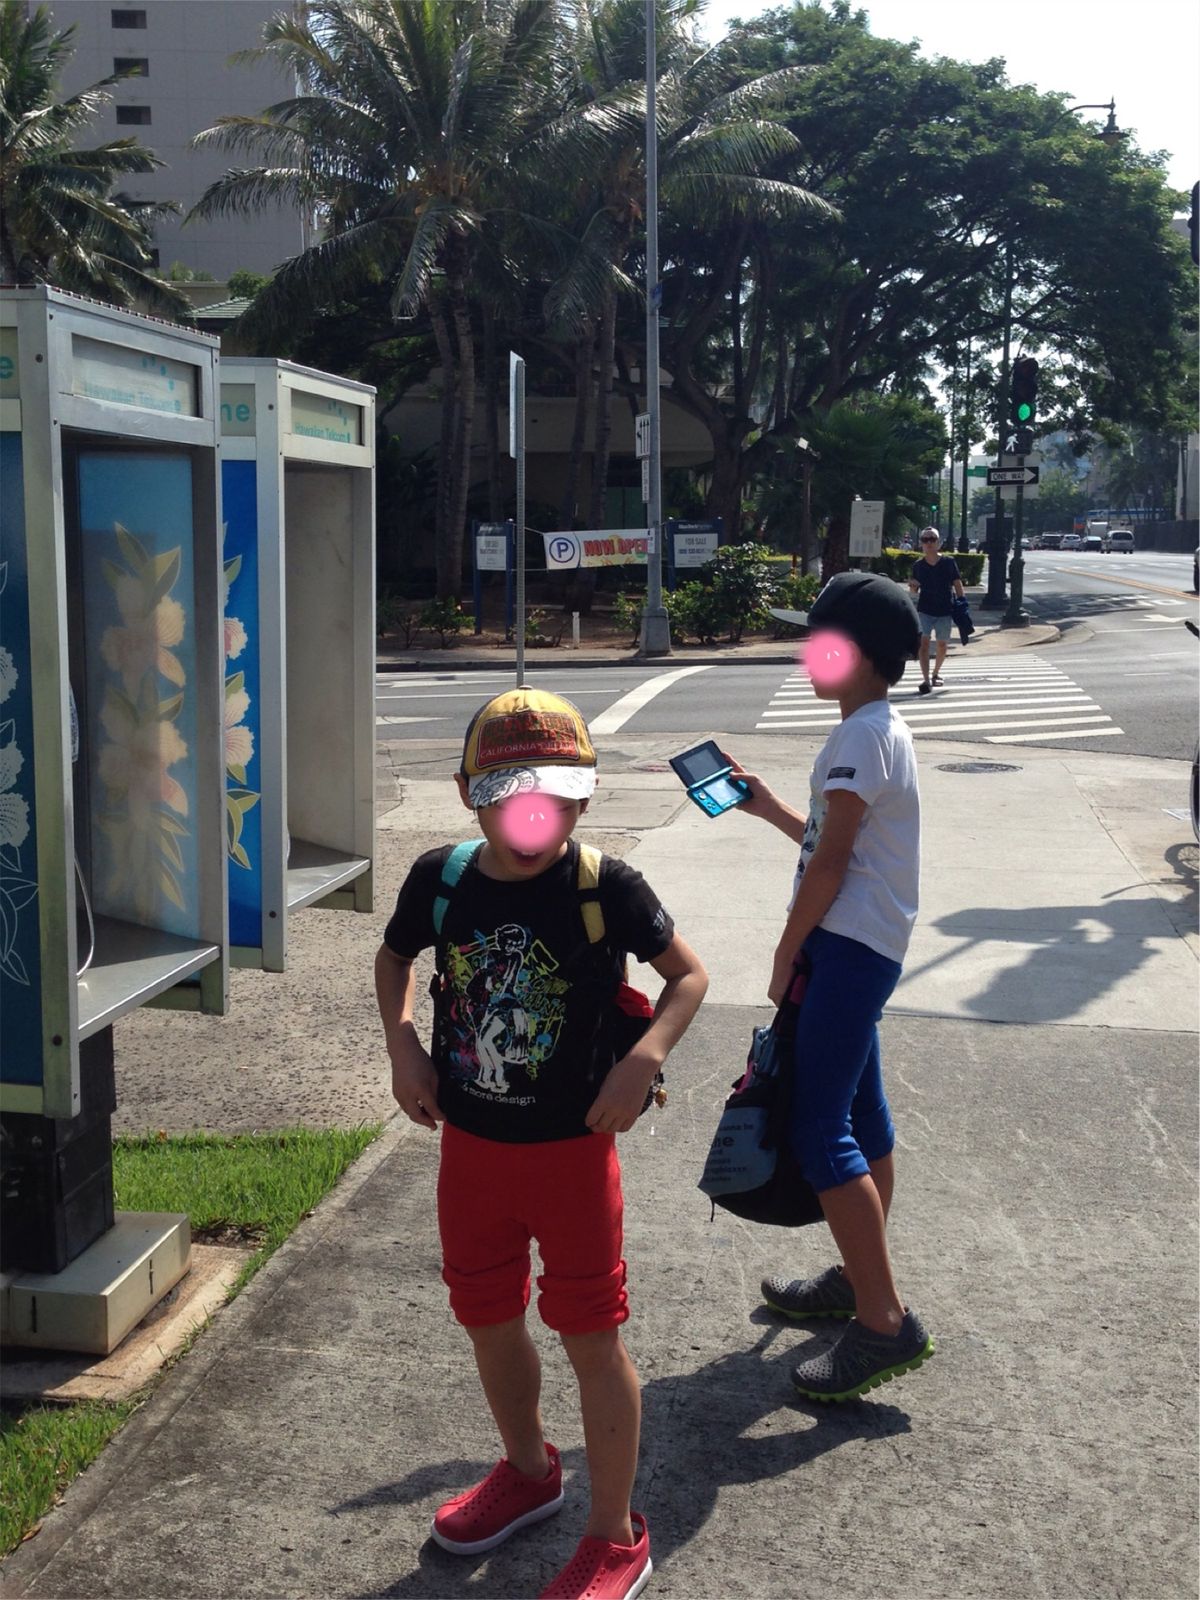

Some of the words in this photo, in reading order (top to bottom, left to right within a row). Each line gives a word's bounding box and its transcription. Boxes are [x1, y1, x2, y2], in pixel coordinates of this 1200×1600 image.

[992, 472, 1008, 481] ONE
[584, 539, 615, 556] NOW
[480, 742, 538, 758] CALIFORNIA
[494, 1093, 537, 1107] design
